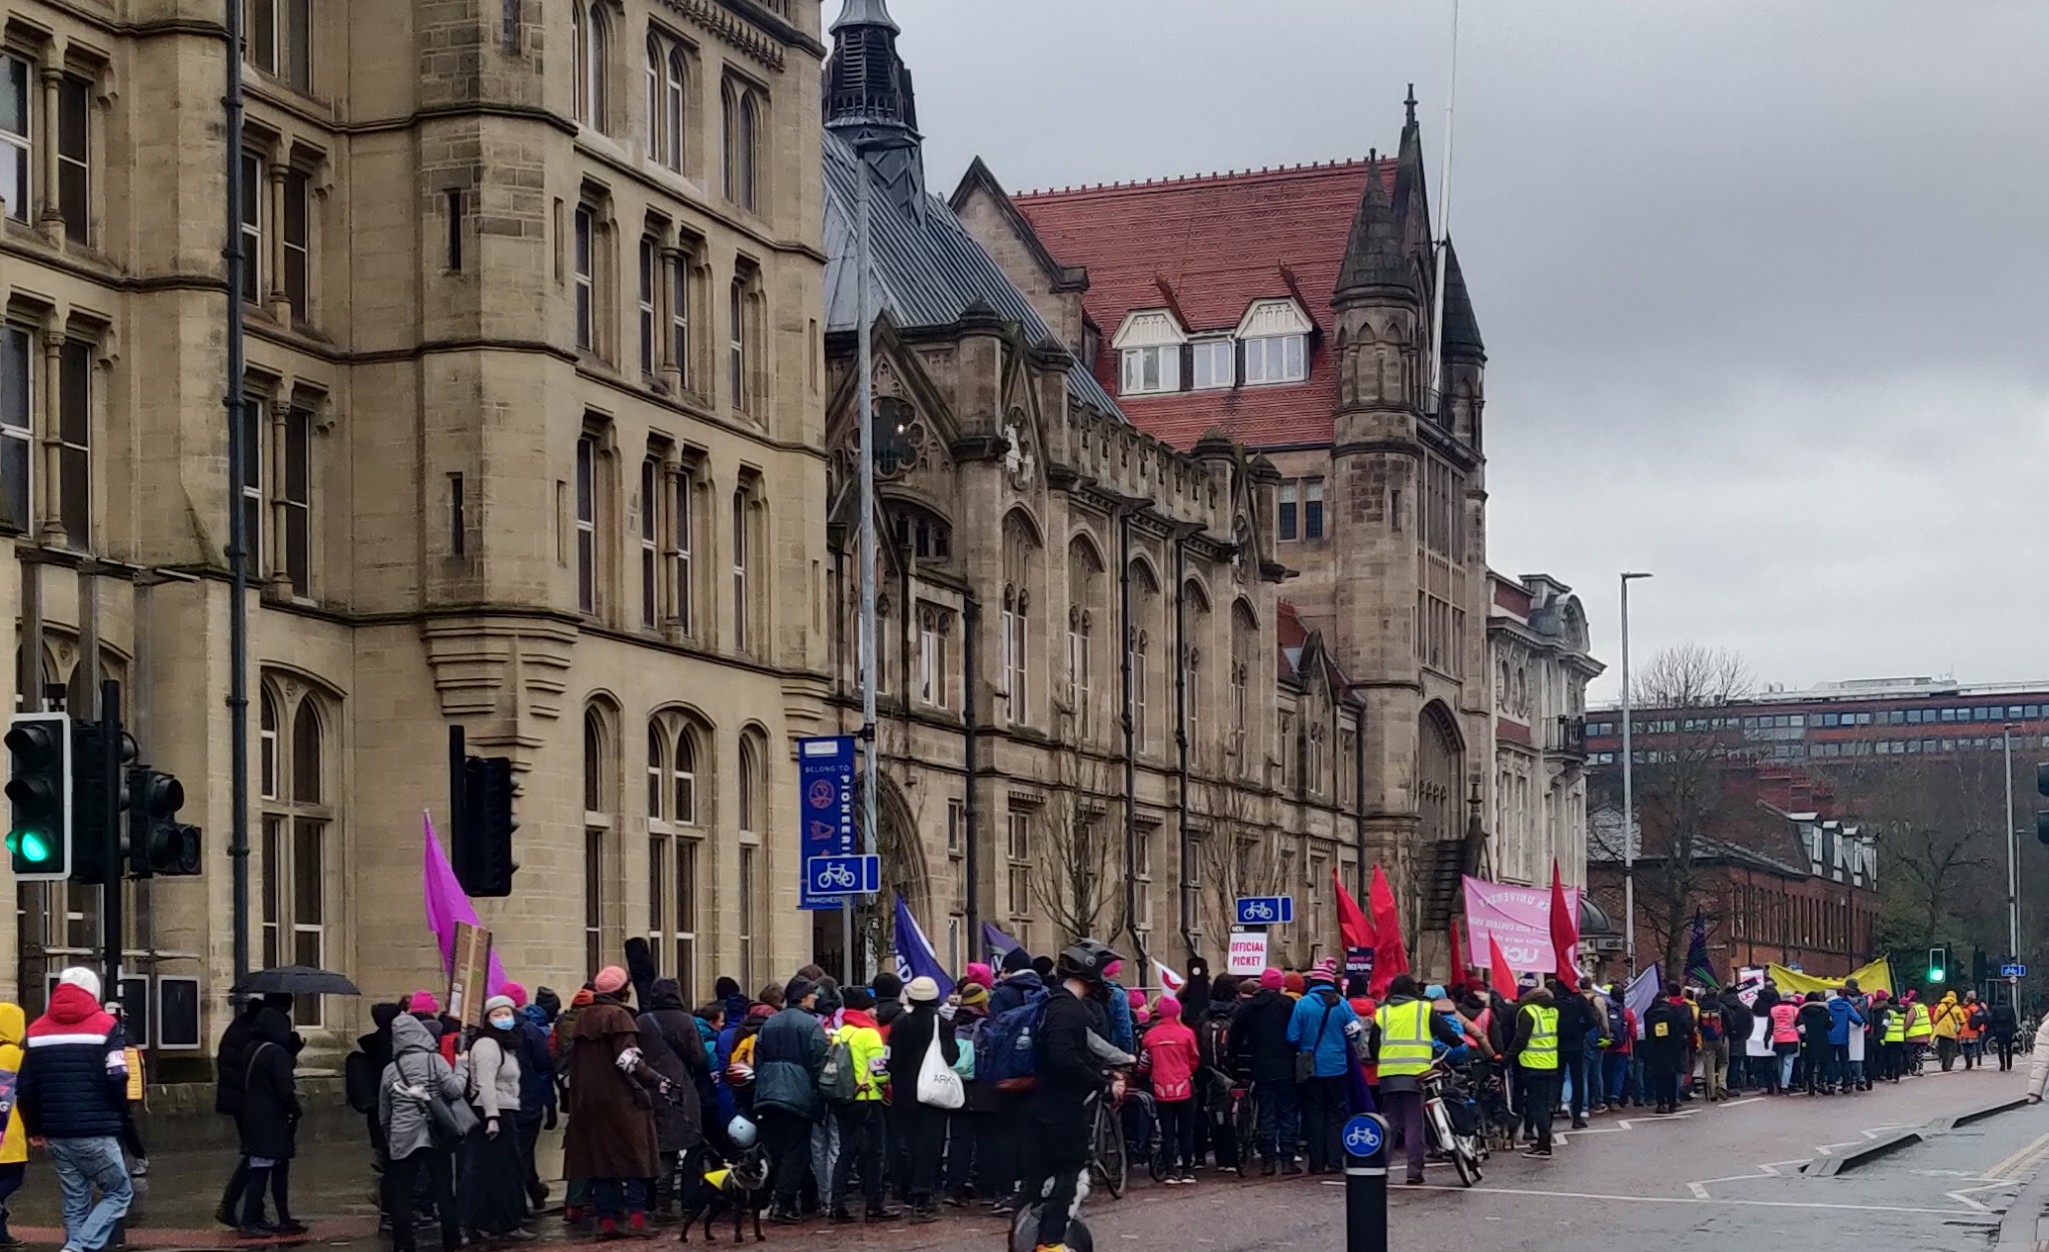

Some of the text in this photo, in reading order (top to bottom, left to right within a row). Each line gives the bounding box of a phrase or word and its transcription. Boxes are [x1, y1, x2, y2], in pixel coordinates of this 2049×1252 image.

[804, 764, 850, 773] BELONG TO
[840, 774, 851, 856] PIONEERI
[1231, 942, 1264, 952] OFFICIAL
[1232, 956, 1261, 966] PICKET
